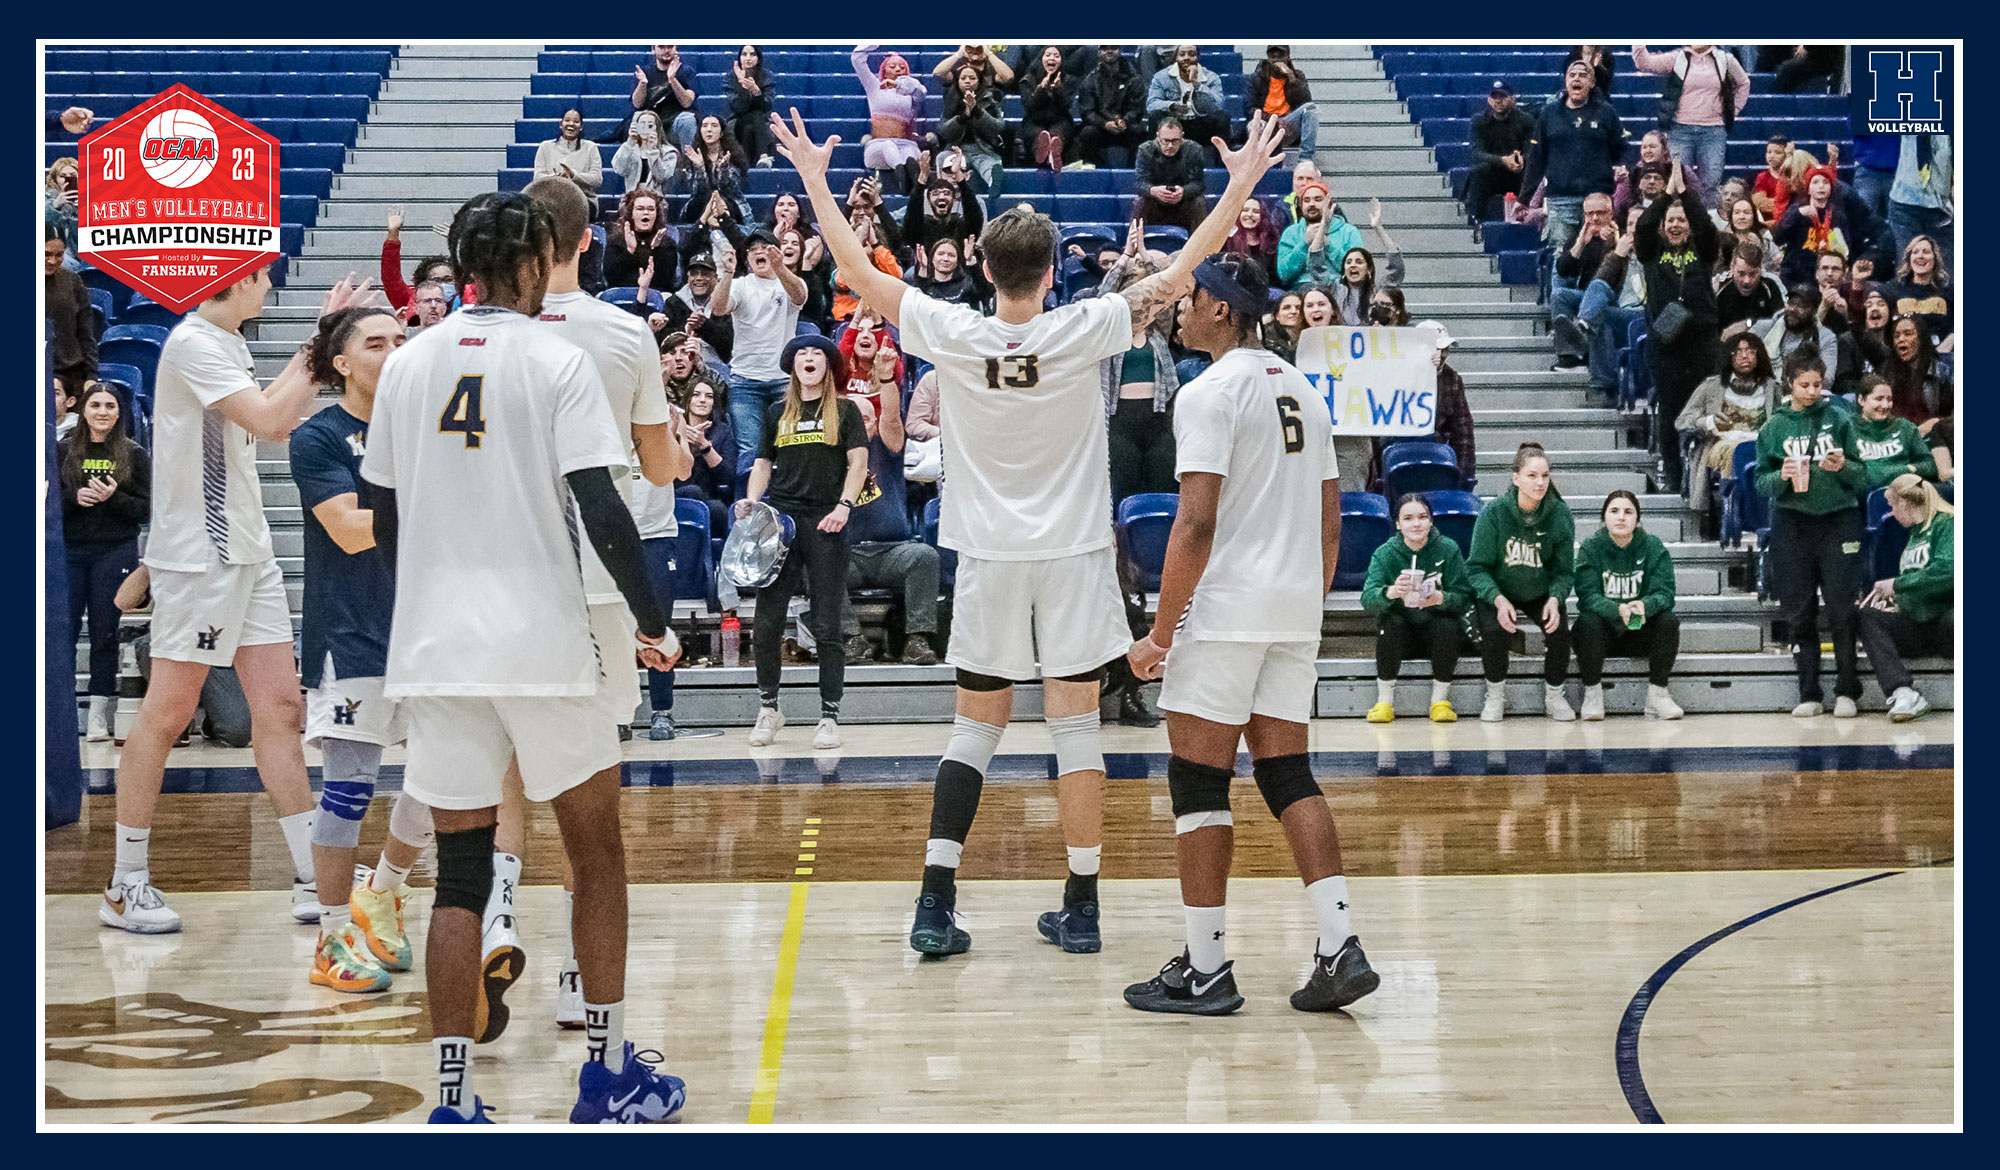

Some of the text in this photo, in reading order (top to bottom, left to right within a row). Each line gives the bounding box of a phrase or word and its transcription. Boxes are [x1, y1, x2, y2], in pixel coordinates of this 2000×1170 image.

[1324, 327, 1404, 361] ROLL
[985, 354, 1039, 390] 13
[438, 373, 487, 450] 4
[1276, 394, 1305, 454] 6
[1857, 439, 1904, 460] SAINTS
